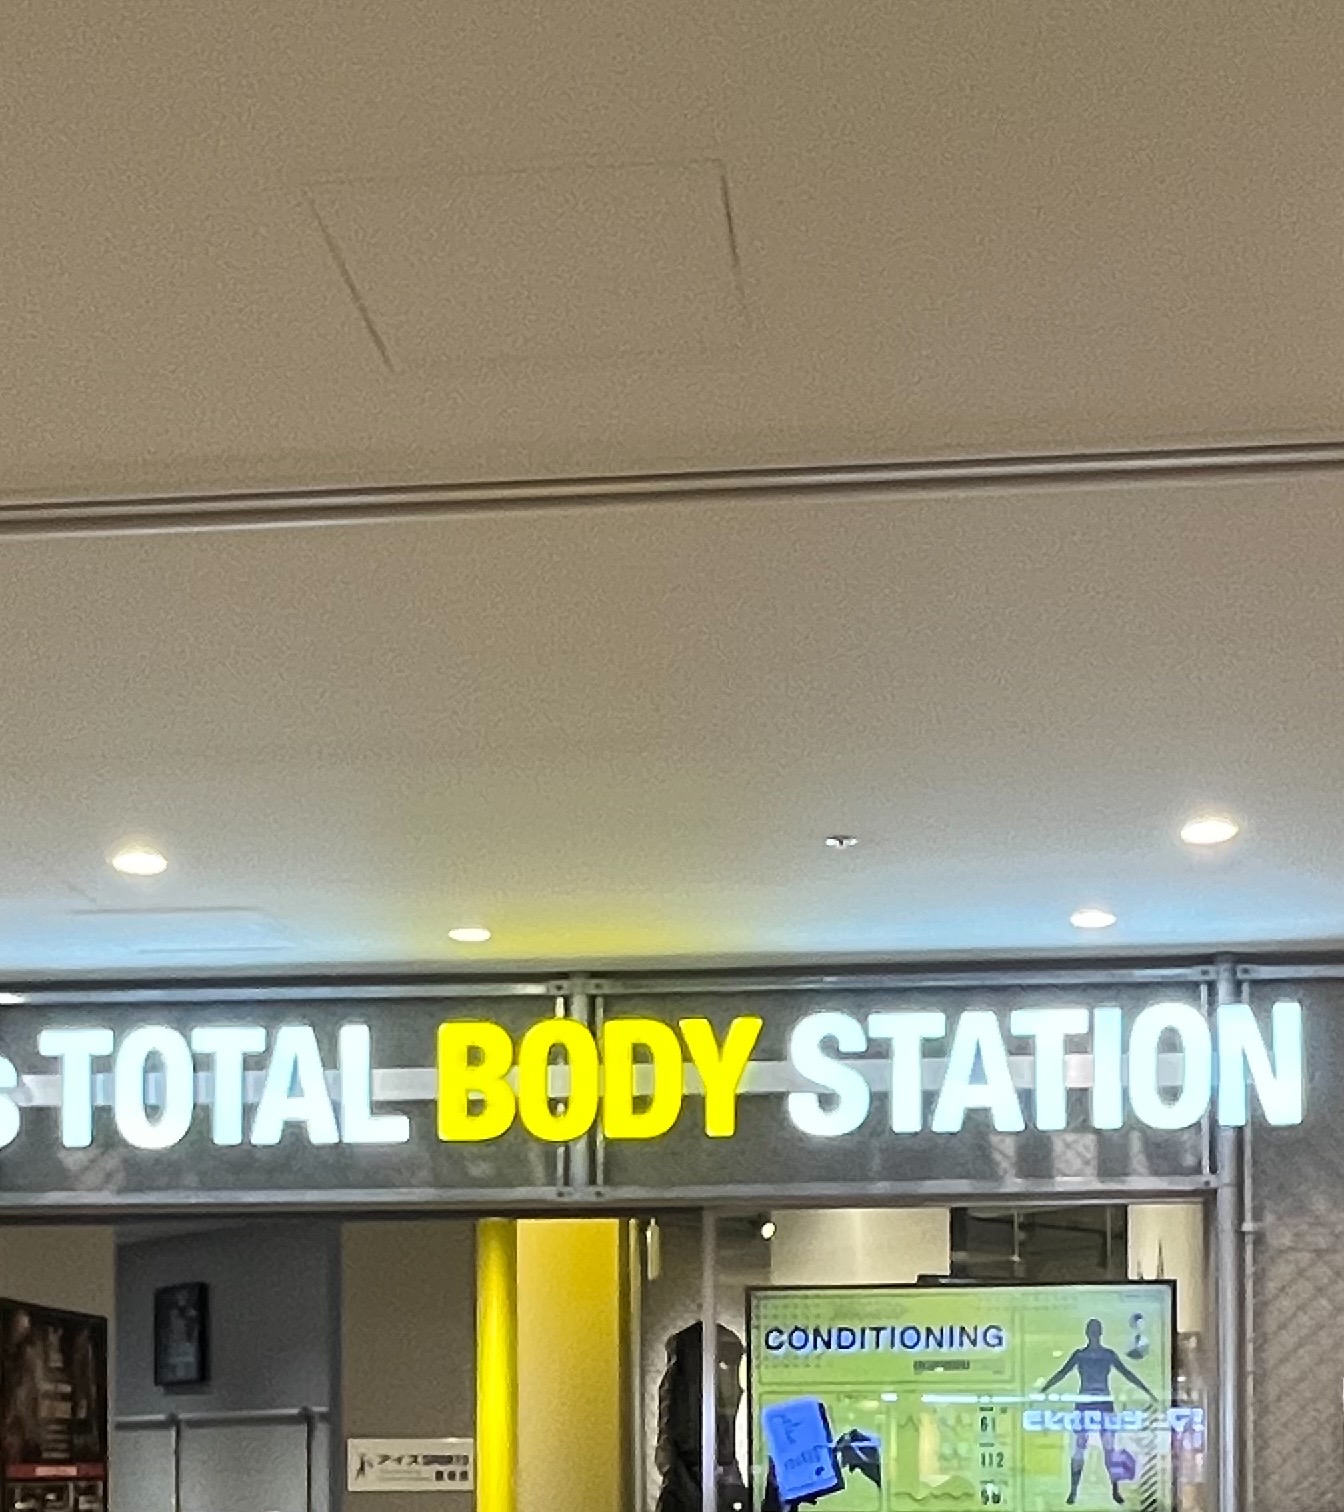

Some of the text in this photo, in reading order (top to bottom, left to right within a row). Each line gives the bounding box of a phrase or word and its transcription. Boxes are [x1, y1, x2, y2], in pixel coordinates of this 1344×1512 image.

[37, 1023, 410, 1150] TOTAL
[436, 1014, 763, 1142] BODY
[787, 1001, 1304, 1138] STATION
[764, 1324, 1006, 1351] CONDITIONING
